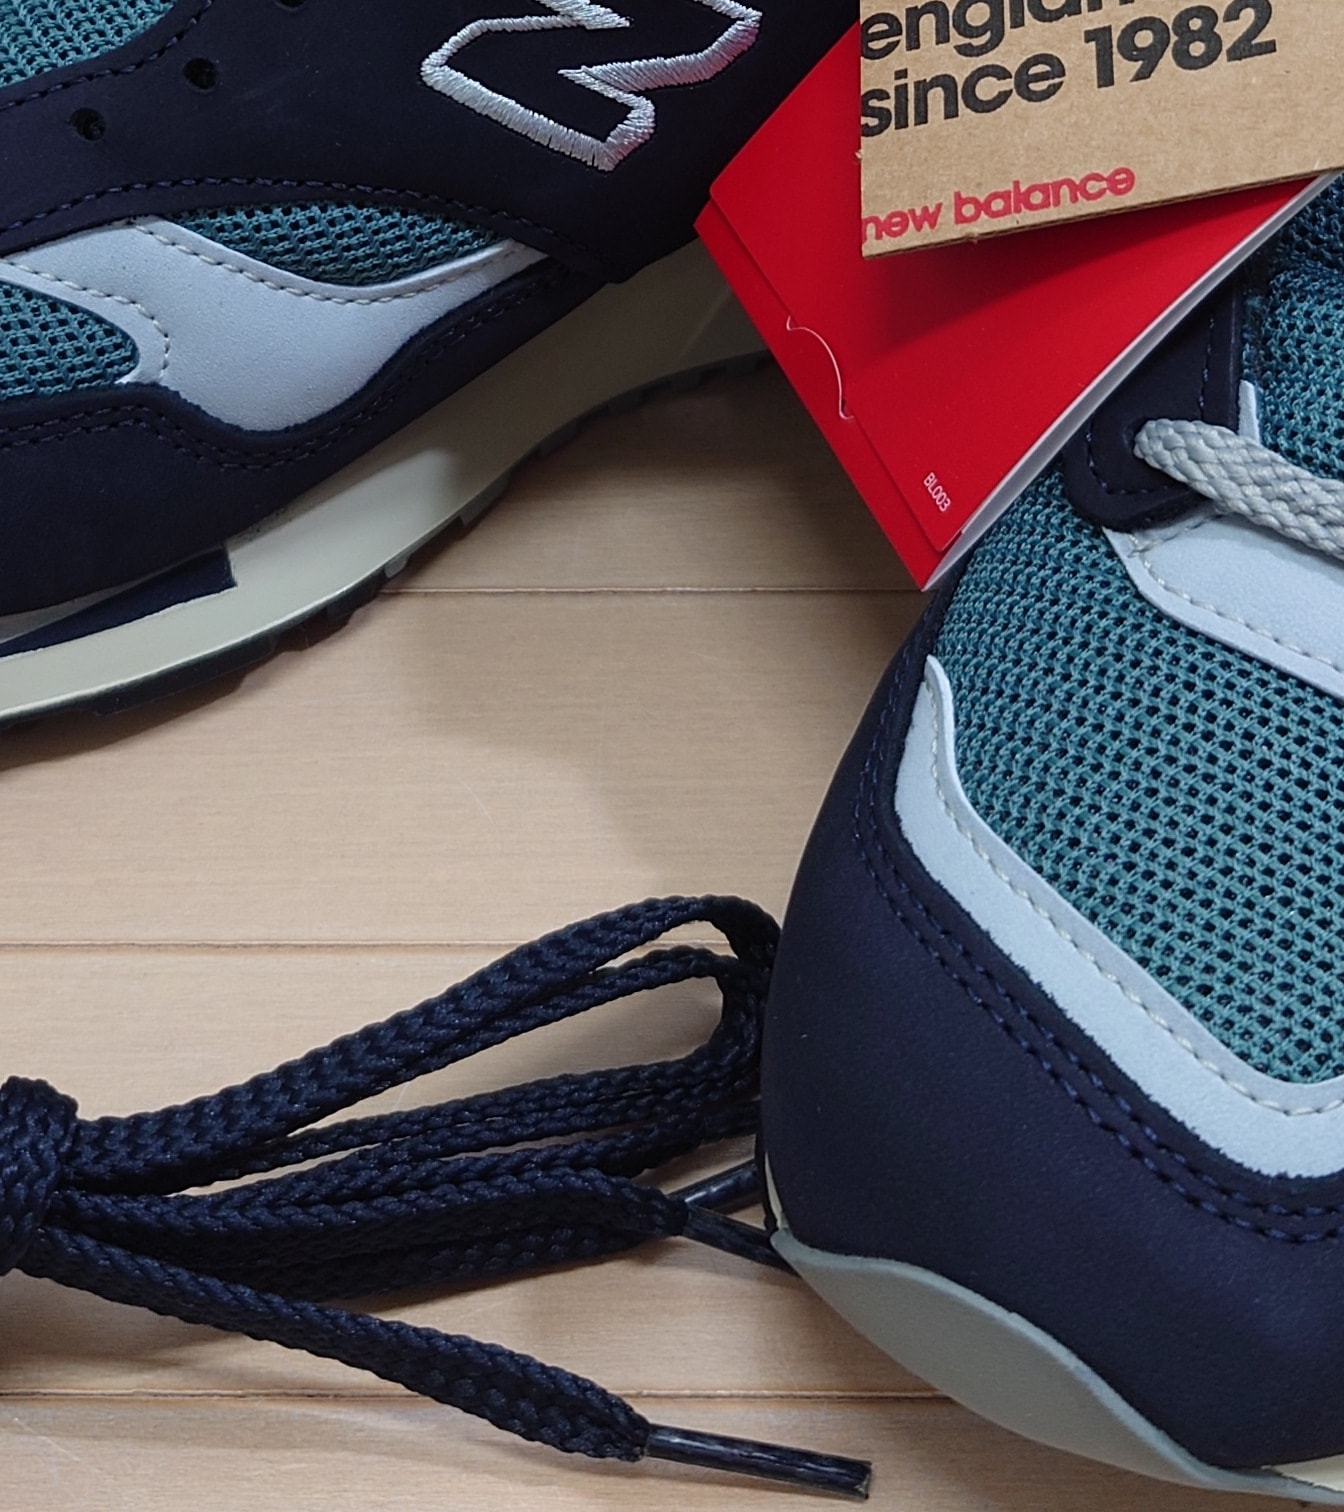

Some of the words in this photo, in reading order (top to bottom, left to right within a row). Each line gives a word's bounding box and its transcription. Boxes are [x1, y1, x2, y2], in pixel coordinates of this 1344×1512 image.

[860, 51, 1066, 138] since
[862, 202, 944, 242] new
[954, 166, 1136, 226] balance
[923, 472, 951, 513] BL003
